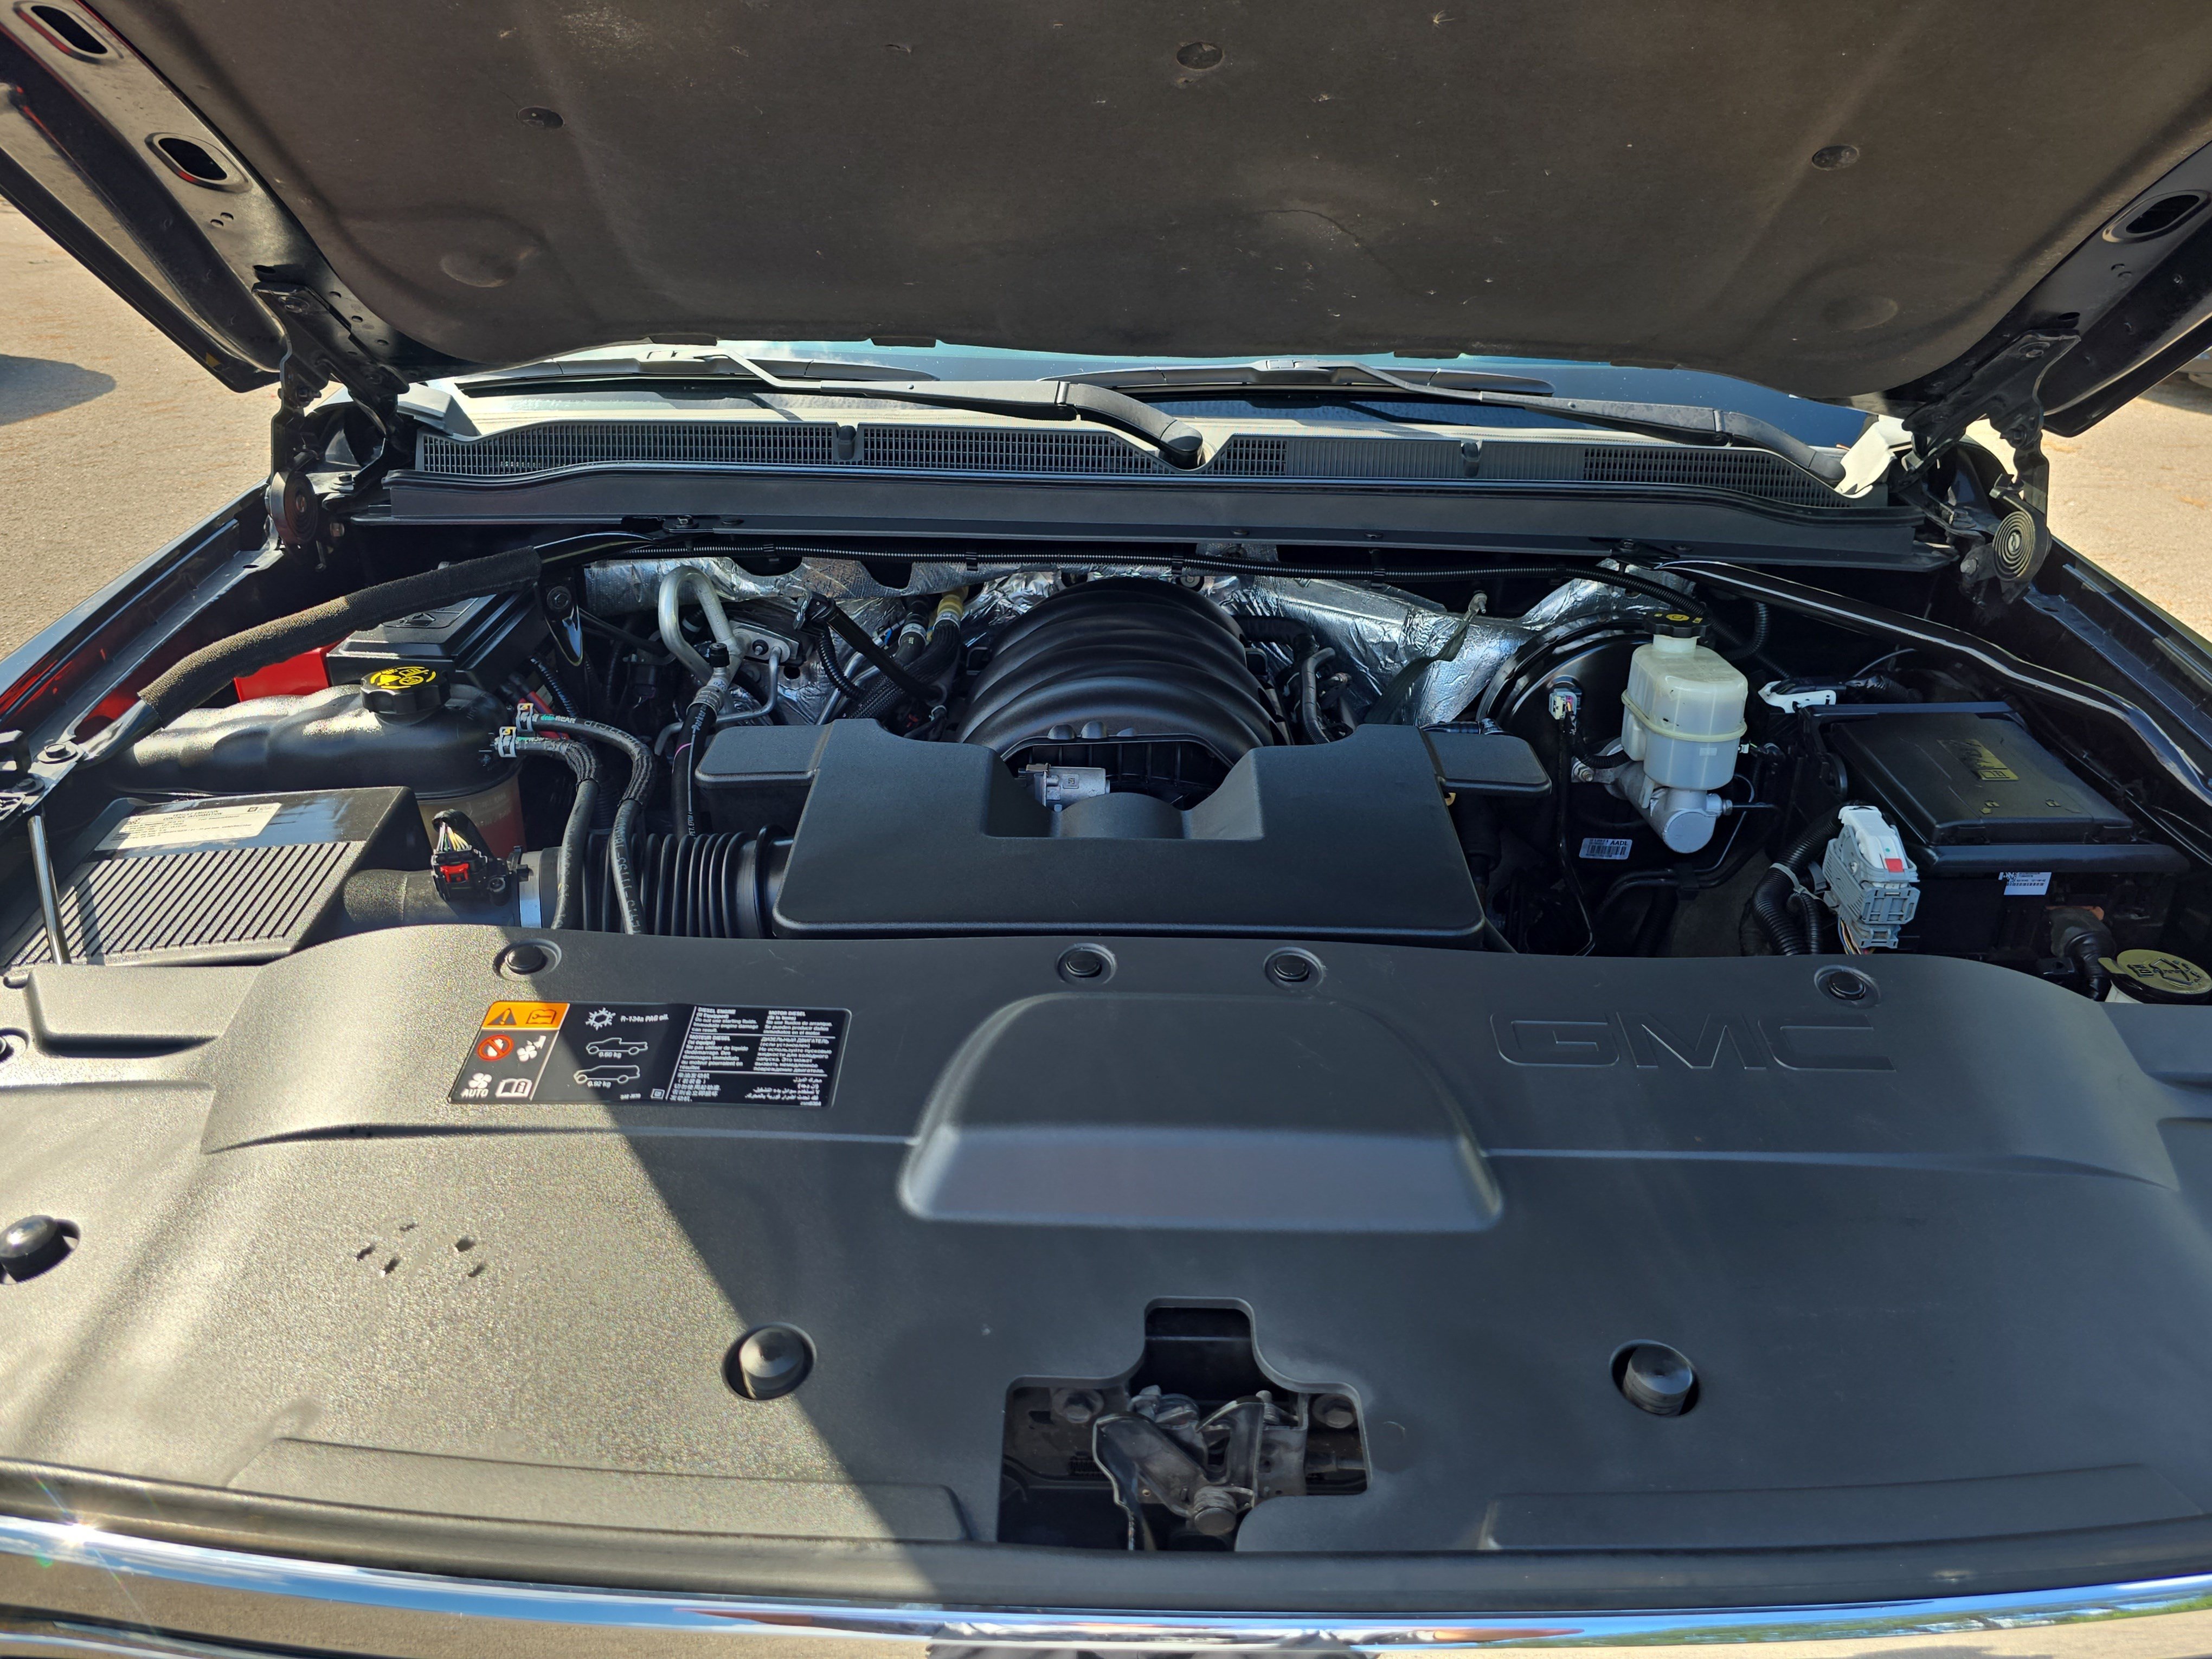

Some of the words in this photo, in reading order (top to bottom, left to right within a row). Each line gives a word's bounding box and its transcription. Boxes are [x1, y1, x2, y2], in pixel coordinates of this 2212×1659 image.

[555, 715, 577, 724] REAR
[691, 709, 706, 731] Parker
[1489, 1011, 1897, 1072] GMC
[460, 1088, 489, 1099] AUTO
